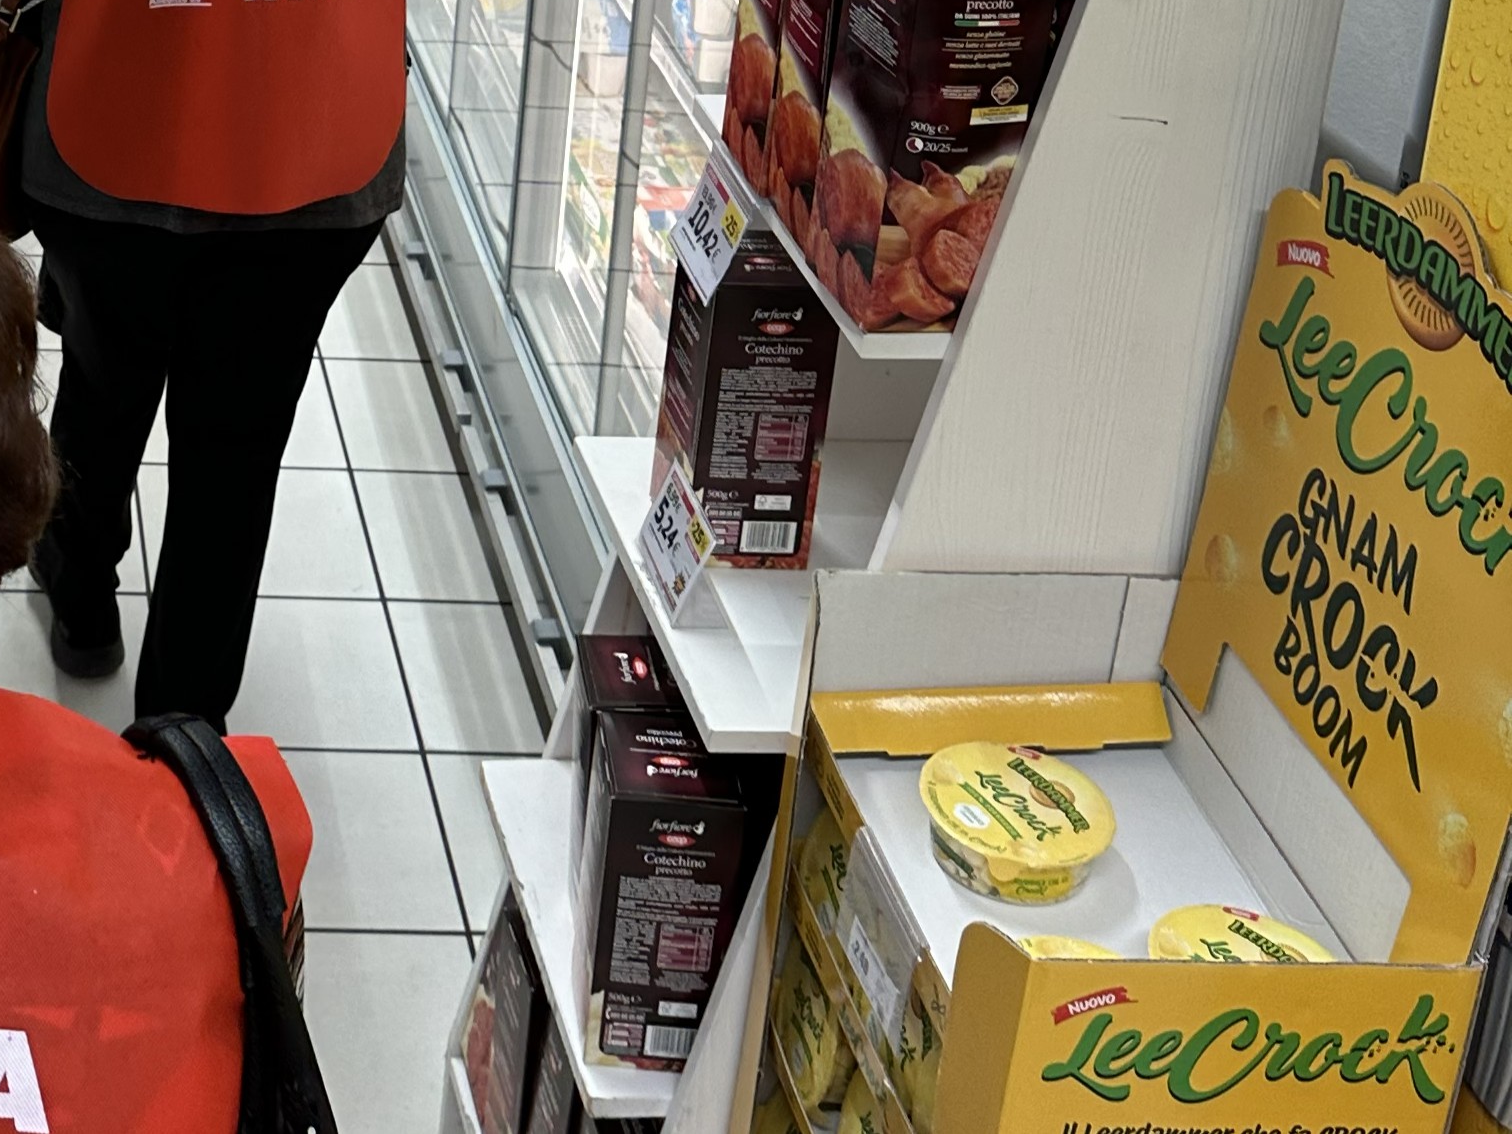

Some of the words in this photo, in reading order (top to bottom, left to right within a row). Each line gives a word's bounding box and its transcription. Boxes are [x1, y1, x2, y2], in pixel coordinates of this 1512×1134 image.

[910, 120, 937, 135] 900g
[923, 141, 951, 154] 20/25
[1324, 171, 1512, 396] LEERDAMME
[745, 343, 804, 356] Cotechino
[1259, 275, 1512, 575] LeeCroc
[1298, 468, 1418, 616] GNAM
[1261, 513, 1438, 793] CROCK
[1274, 615, 1368, 789] BOOM
[1007, 757, 1091, 834] LEERDAMMER
[644, 853, 706, 869] Cotechino
[1228, 919, 1298, 962] LEERDA
[1041, 993, 1451, 1104] LeeCrock
